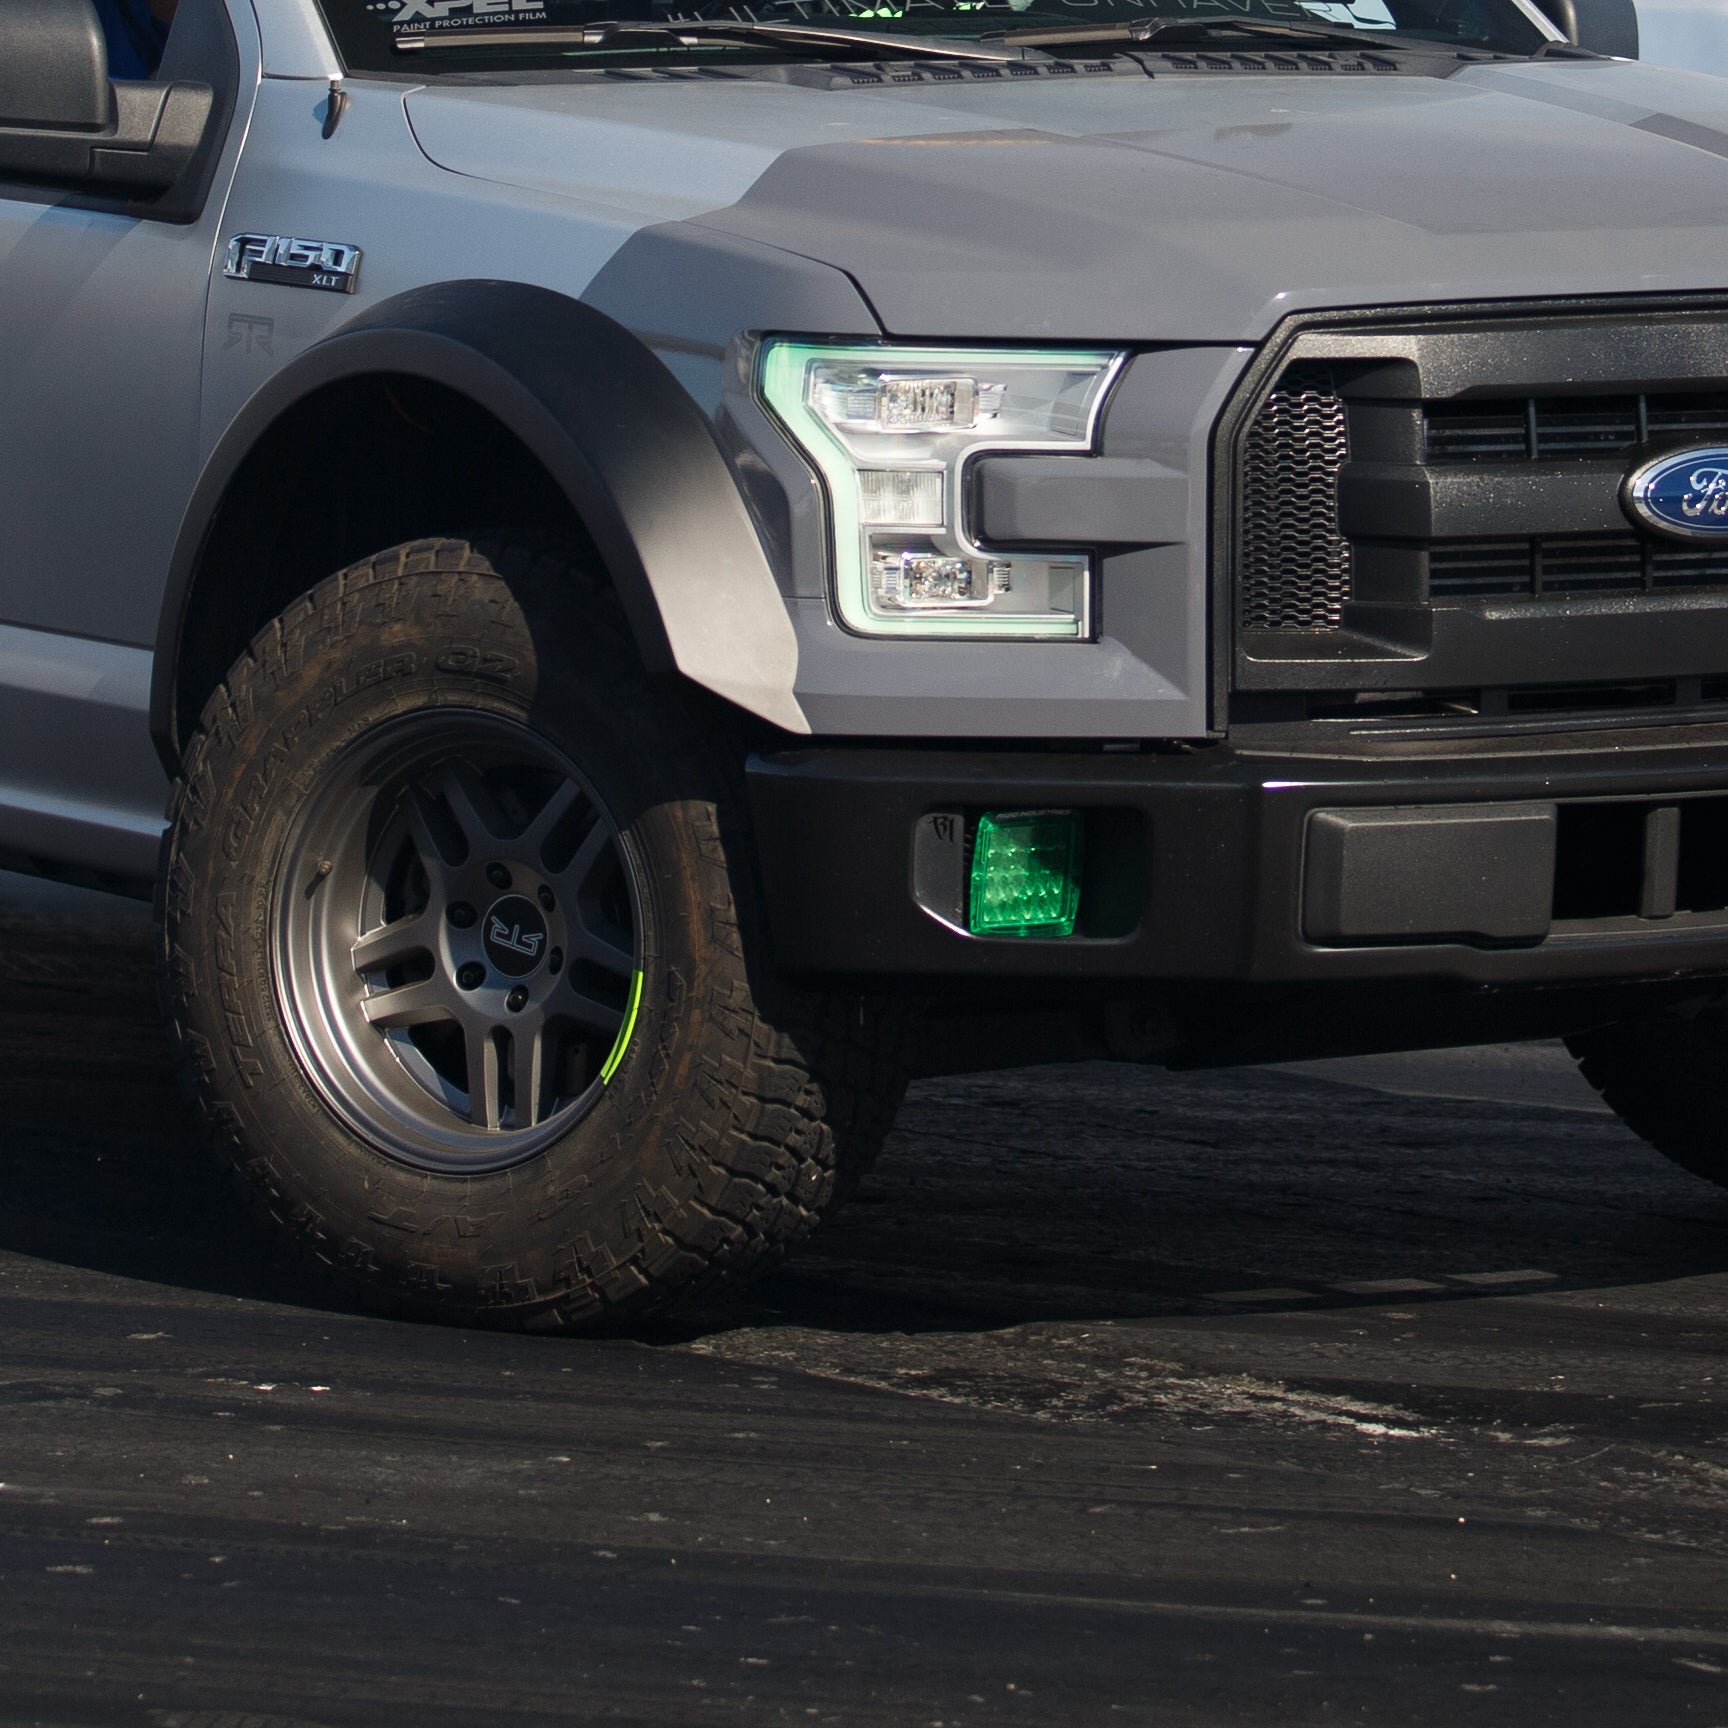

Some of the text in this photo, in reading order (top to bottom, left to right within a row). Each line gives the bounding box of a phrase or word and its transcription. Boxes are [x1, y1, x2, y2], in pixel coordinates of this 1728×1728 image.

[392, 10, 548, 33] PAINT PROTECTION FILM
[311, 273, 340, 286] XLT
